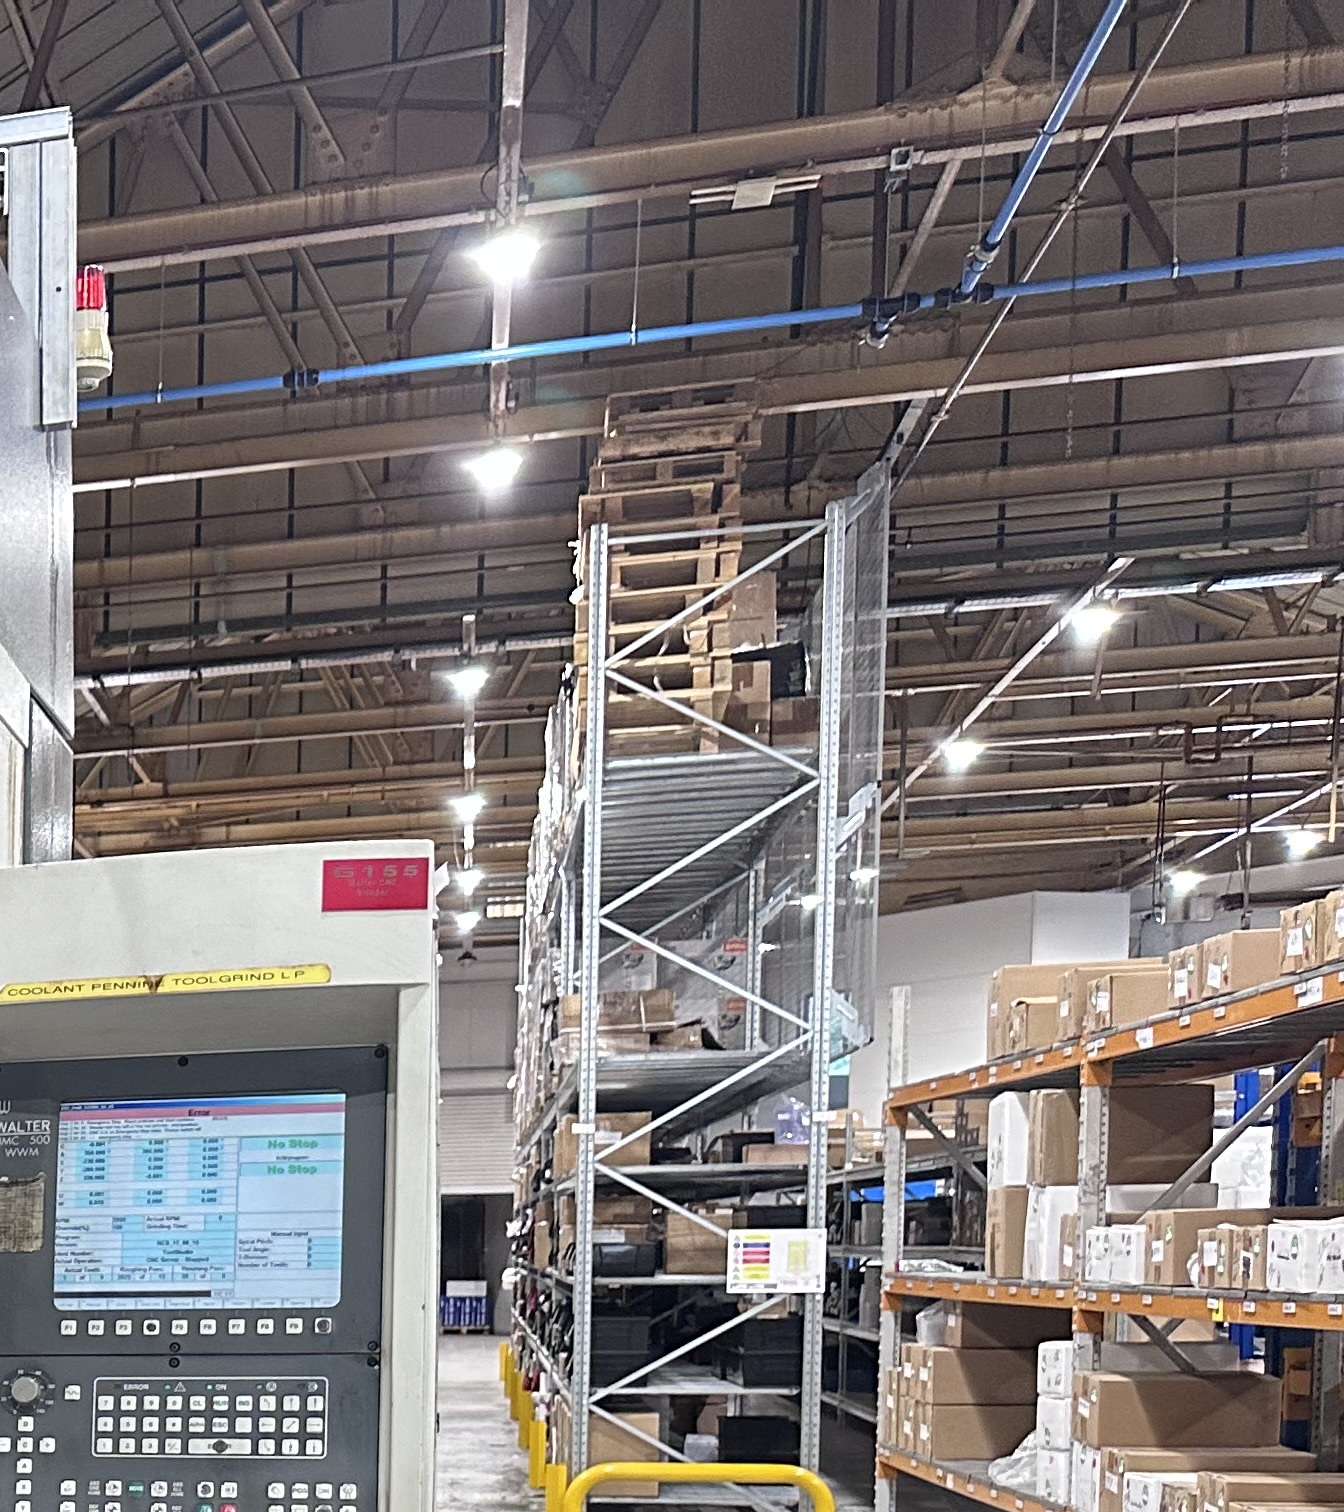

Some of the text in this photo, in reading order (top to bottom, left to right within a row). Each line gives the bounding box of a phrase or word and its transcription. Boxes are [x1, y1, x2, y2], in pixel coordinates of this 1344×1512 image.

[7, 984, 85, 997] COOLANT
[172, 971, 275, 986] TOOLGRIND
[187, 1109, 212, 1117] Error
[29, 1135, 51, 1145] 500
[268, 1138, 318, 1149] No Stop
[4, 1148, 40, 1157] WWM
[267, 1164, 318, 1175] No Stop
